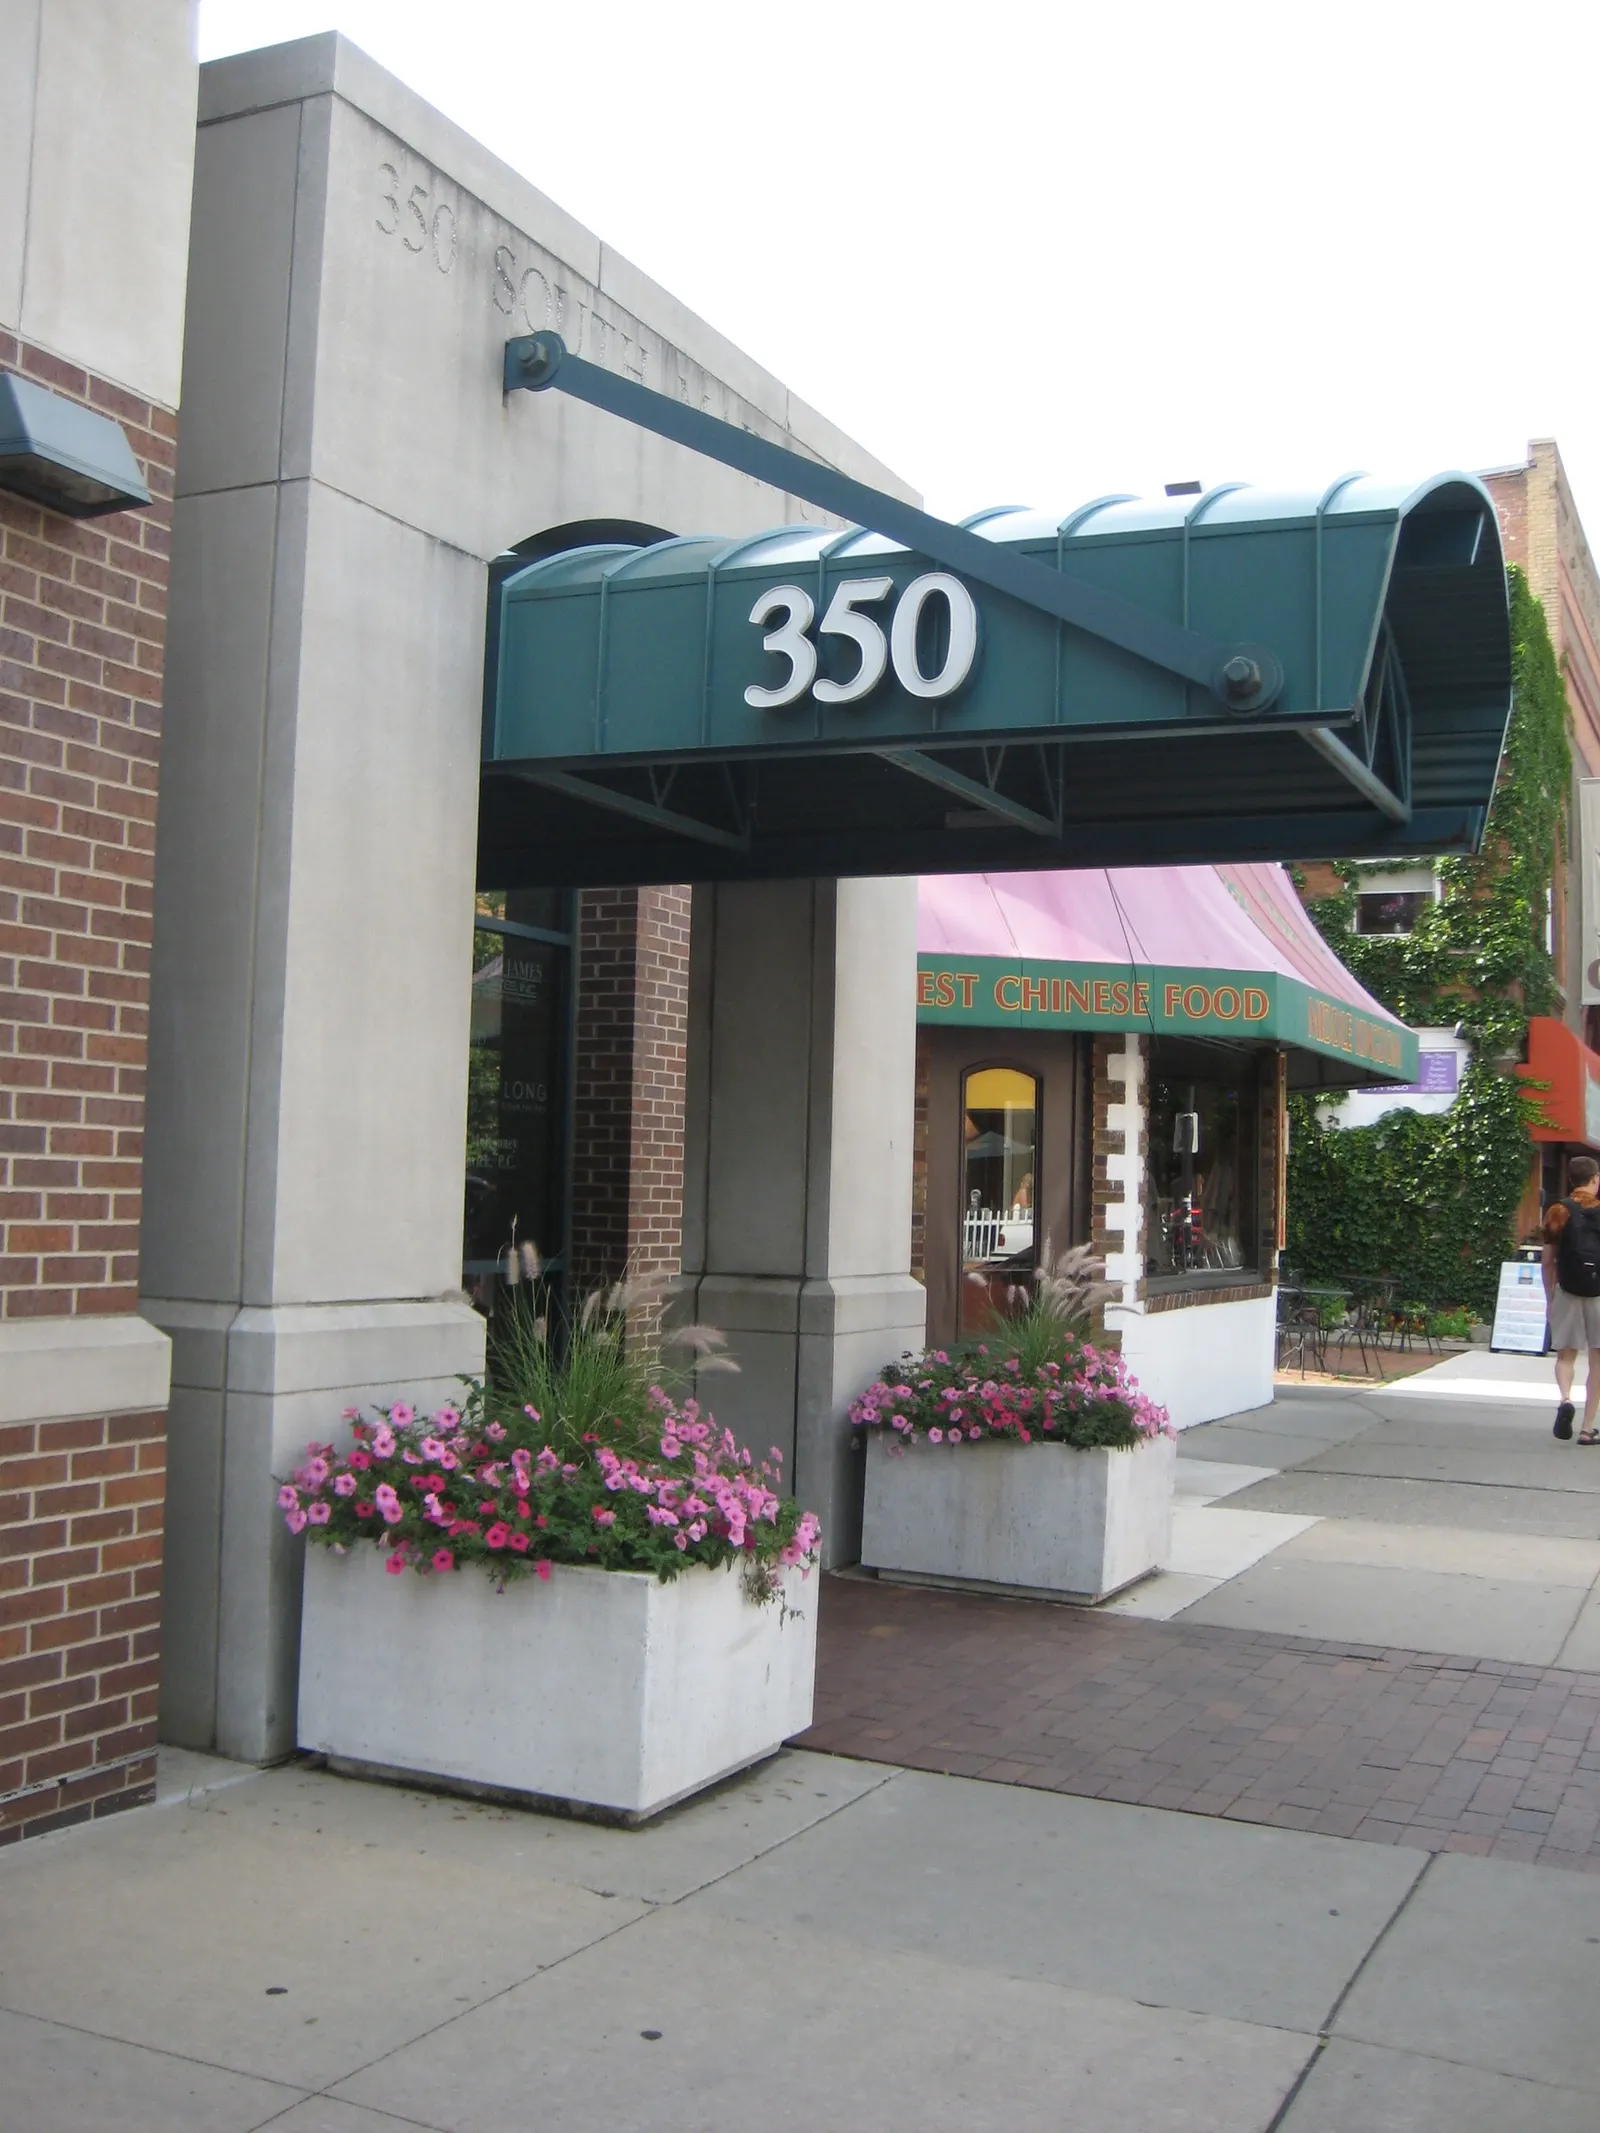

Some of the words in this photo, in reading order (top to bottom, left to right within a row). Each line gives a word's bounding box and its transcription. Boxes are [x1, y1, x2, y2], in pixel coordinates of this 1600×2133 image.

[375, 163, 457, 274] 350
[492, 246, 650, 384] SOUTH
[744, 572, 977, 708] 350
[993, 975, 1151, 1017] CHINESE
[1163, 983, 1271, 1022] FOOD
[503, 1080, 549, 1102] LONG
